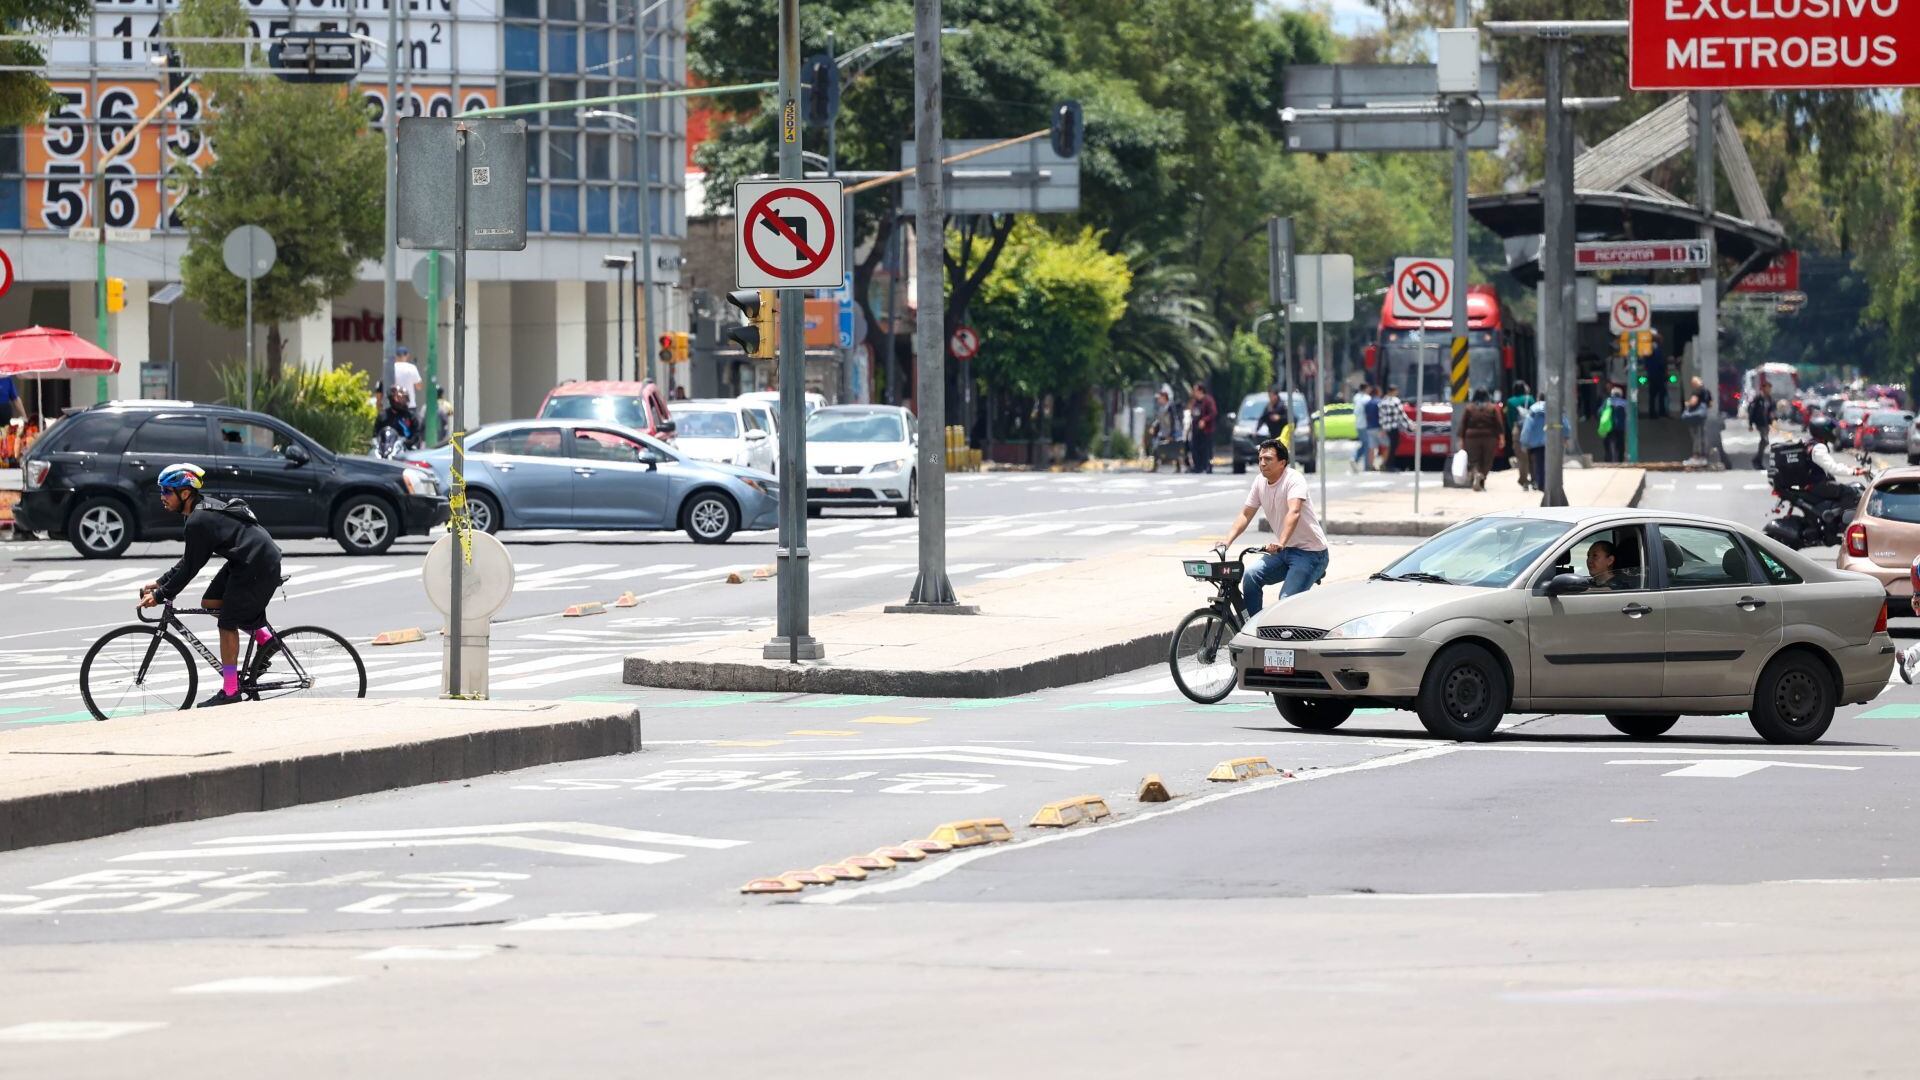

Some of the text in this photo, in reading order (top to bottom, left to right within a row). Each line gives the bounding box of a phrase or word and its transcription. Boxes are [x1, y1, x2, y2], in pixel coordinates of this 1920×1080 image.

[1665, 0, 1899, 20] EXCLUSIVO
[1666, 35, 1897, 70] METROBUS
[45, 88, 138, 158] 56
[44, 164, 138, 228] 56
